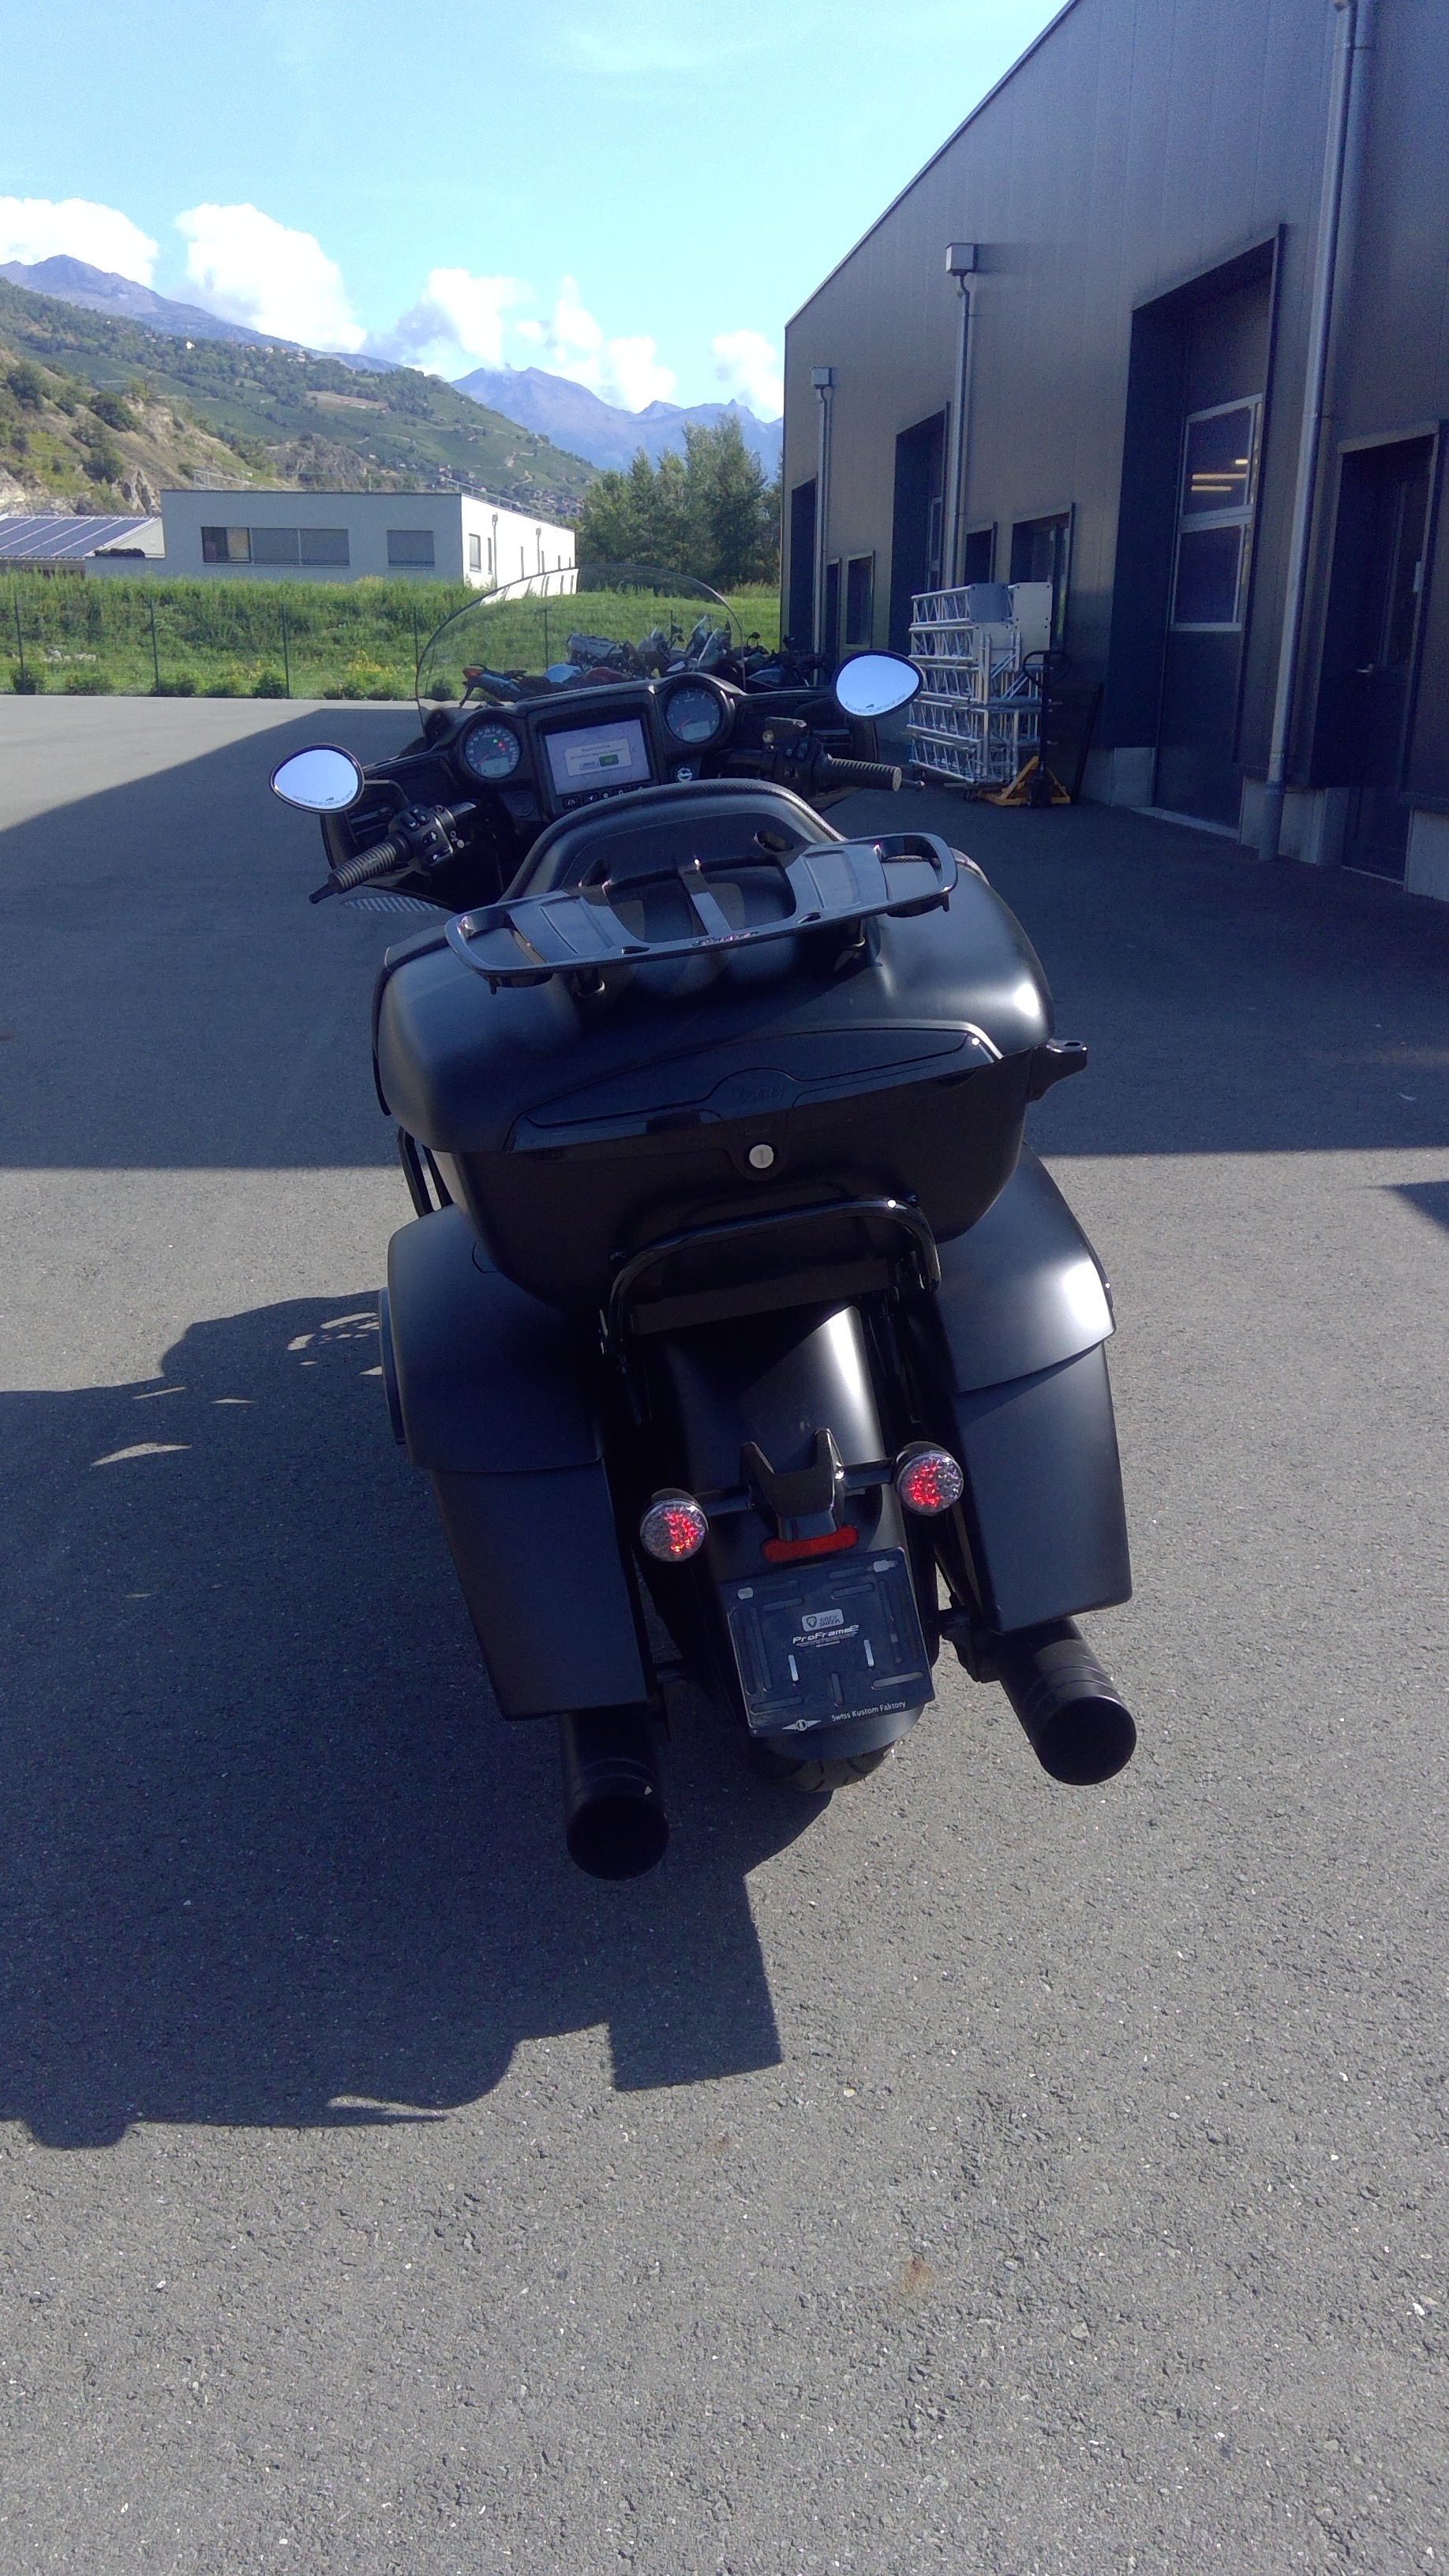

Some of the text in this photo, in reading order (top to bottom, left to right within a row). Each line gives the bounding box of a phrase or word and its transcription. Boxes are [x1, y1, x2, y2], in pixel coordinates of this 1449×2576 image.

[831, 1701, 906, 1722] Swiss Kustom Faktory
